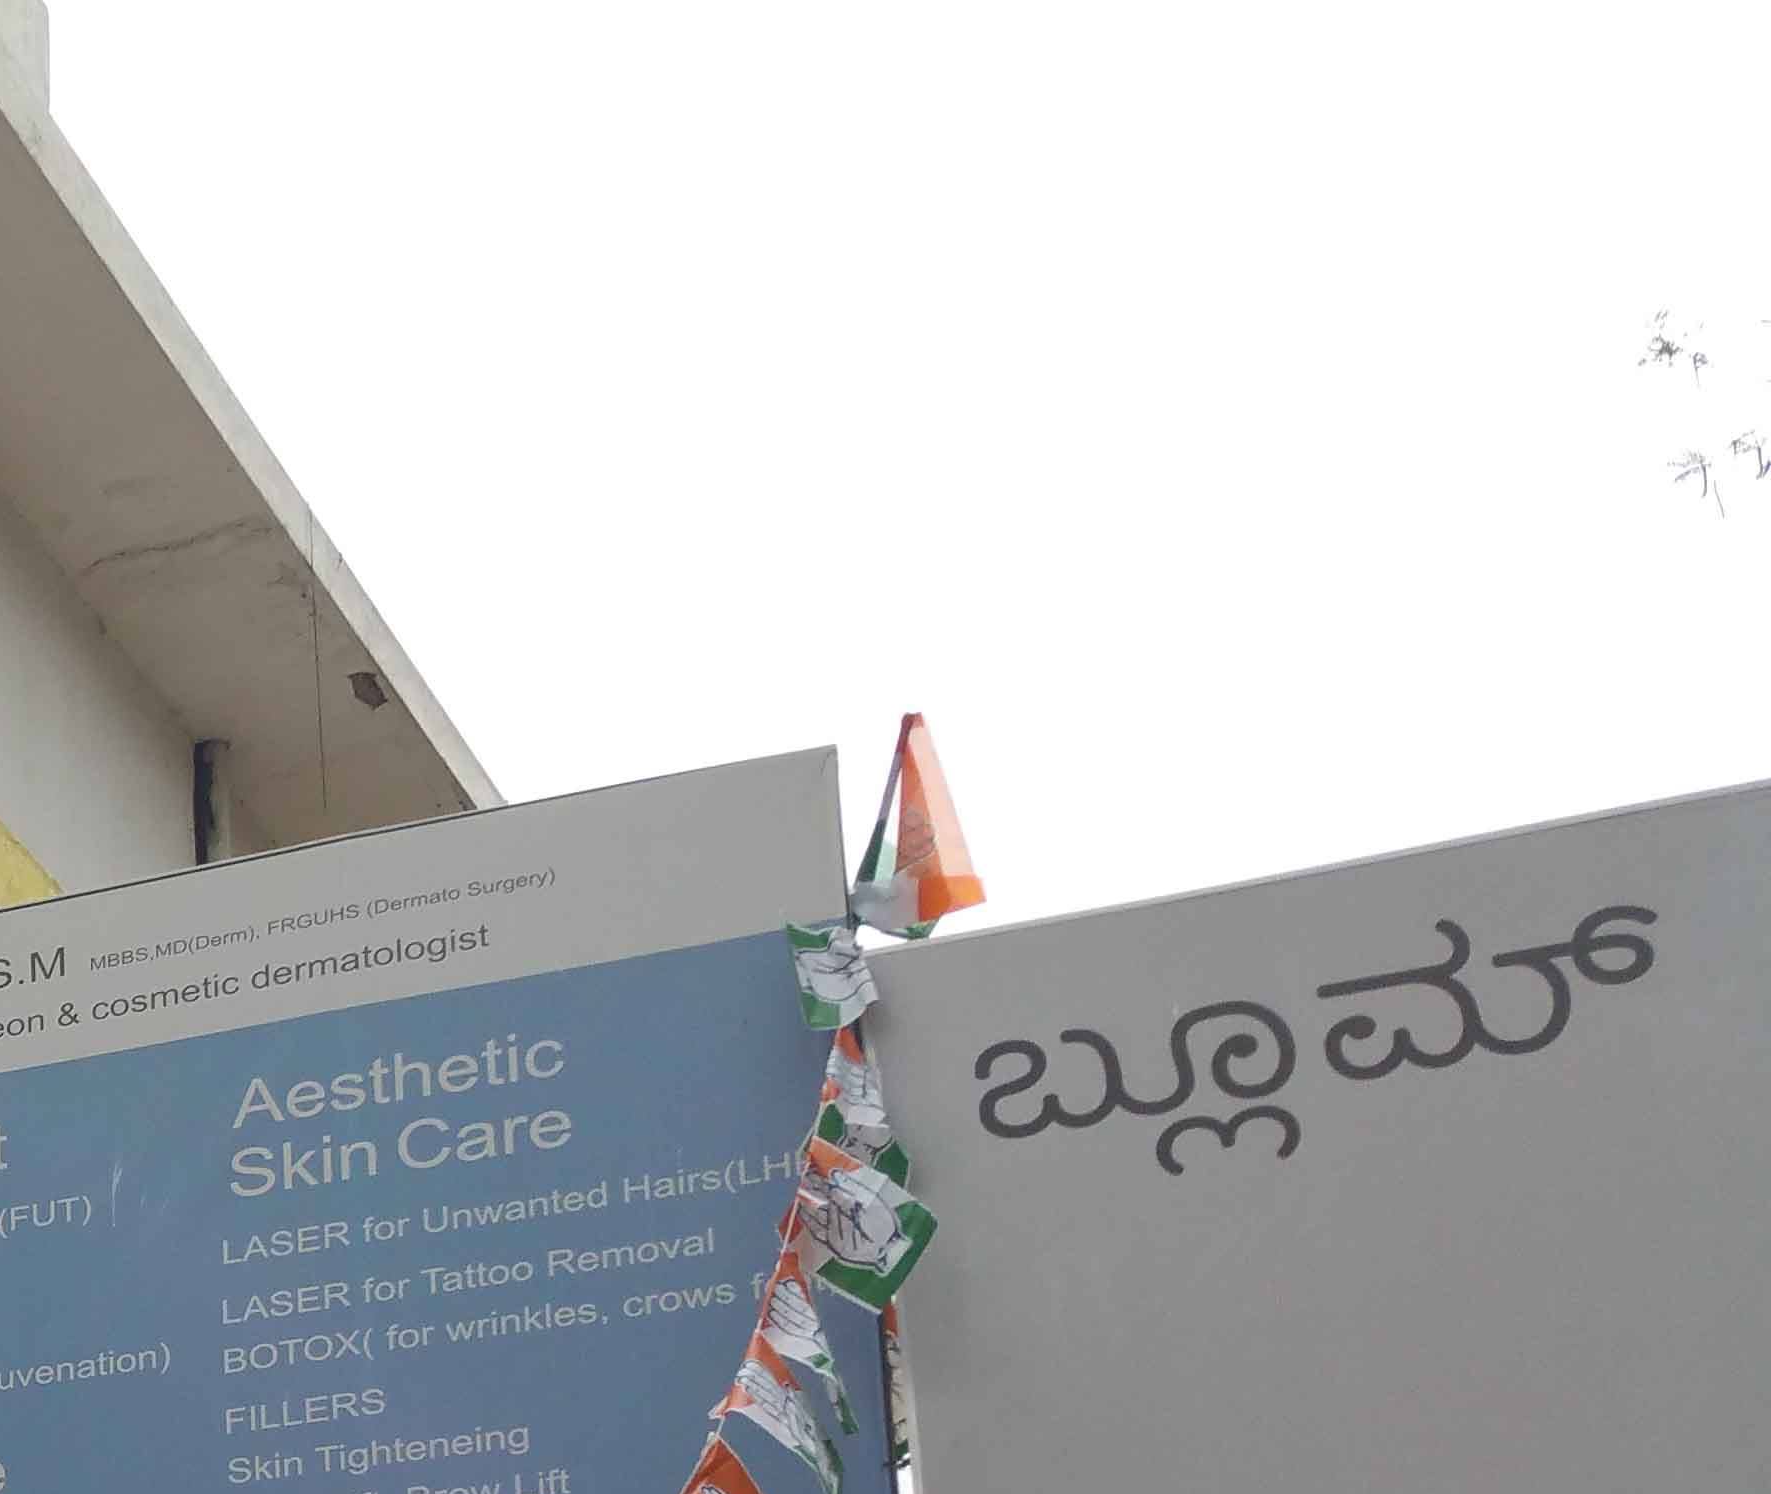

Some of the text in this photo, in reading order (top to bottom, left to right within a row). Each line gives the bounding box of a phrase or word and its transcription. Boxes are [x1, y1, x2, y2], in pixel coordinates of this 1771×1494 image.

[268, 904, 359, 934] FRGUHS
[367, 889, 460, 918] (Dermato
[468, 868, 555, 896] Surgery)
[58, 1003, 79, 1026] &
[93, 977, 238, 1019] cosmetic
[252, 925, 489, 988] dermatologist
[233, 1034, 563, 1128] Aesthetic
[975, 905, 1658, 1176] ಬ್ಲೂಮ್
[231, 1111, 571, 1196] Skin Care
[223, 1181, 607, 1264] LASER for Unwanted
[223, 1227, 714, 1324] LASER for Tattoo Removal
[224, 1328, 373, 1373] BOTOX(
[387, 1324, 434, 1350] for
[446, 1303, 607, 1341] wrinkles,
[624, 1284, 735, 1317] crows
[226, 1389, 385, 1433] FILLERS
[229, 1427, 529, 1483] Skin Tighteneing
